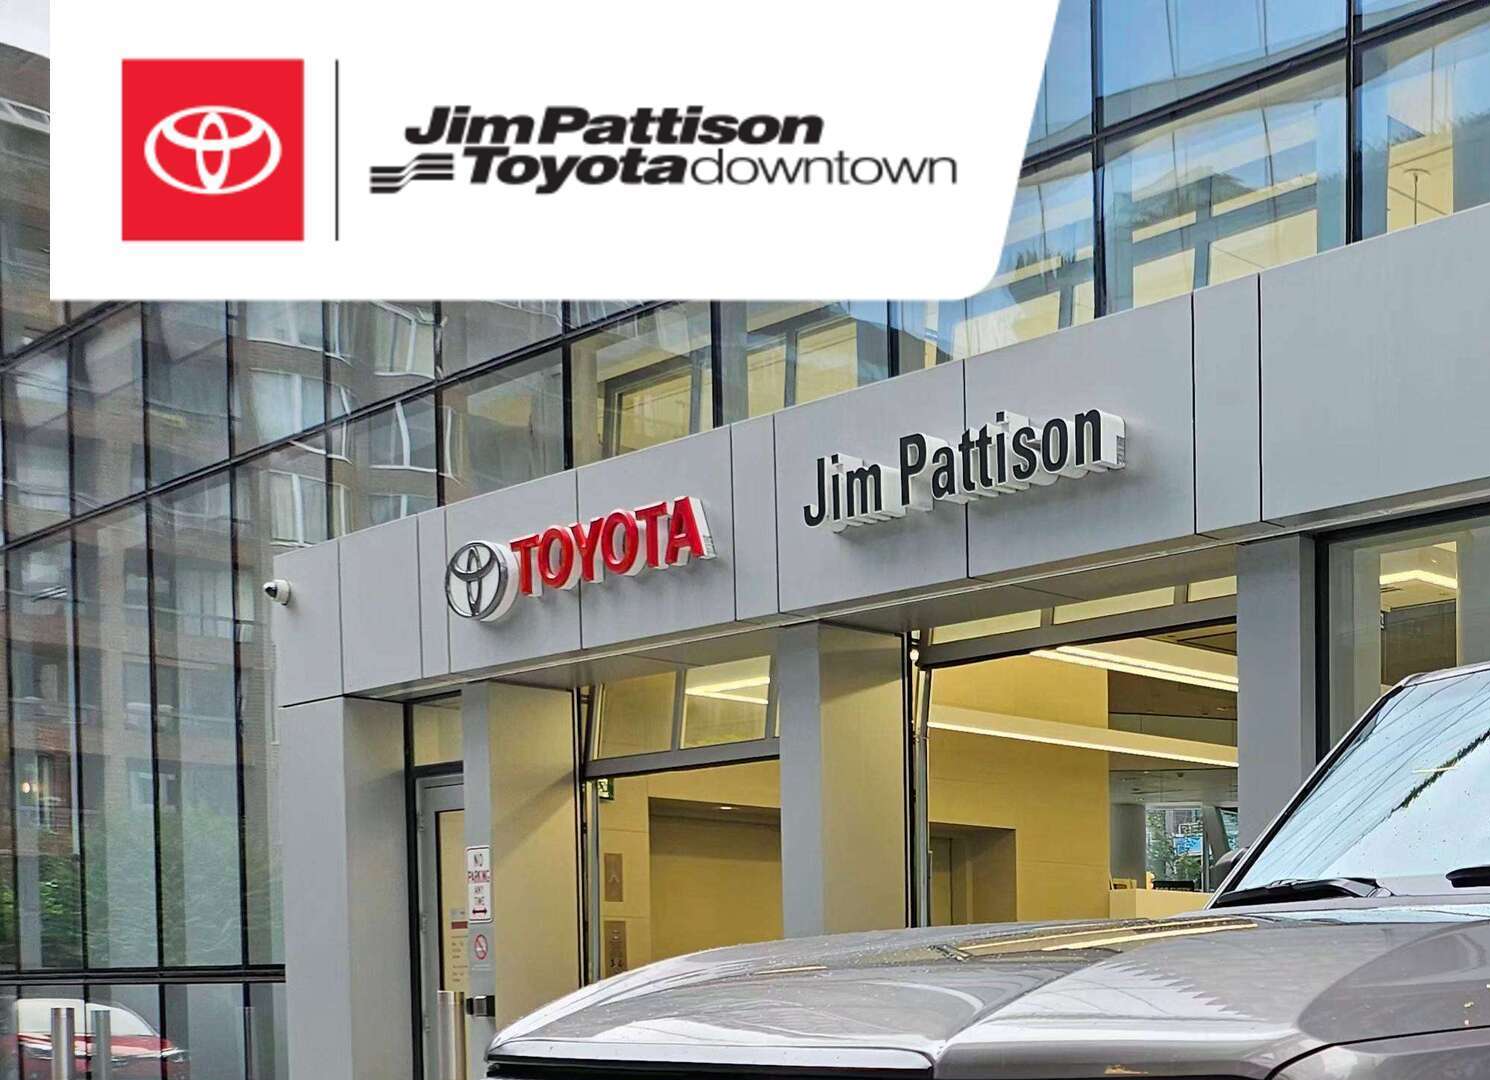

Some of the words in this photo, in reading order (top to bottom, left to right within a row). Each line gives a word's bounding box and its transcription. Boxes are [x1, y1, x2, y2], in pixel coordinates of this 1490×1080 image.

[803, 453, 886, 528] Jim
[899, 409, 1108, 508] Pattison
[509, 496, 709, 597] TOYOTA
